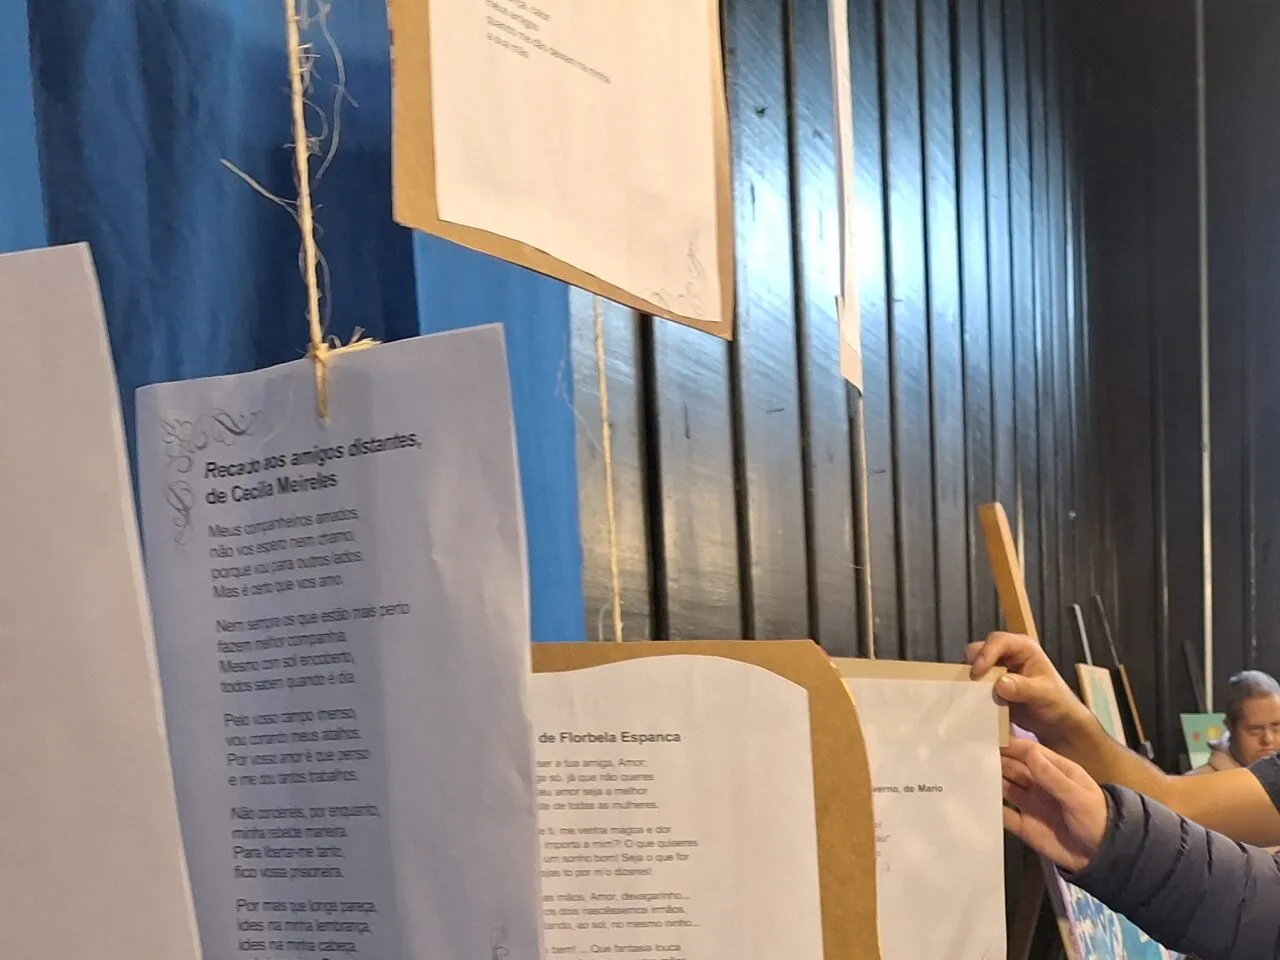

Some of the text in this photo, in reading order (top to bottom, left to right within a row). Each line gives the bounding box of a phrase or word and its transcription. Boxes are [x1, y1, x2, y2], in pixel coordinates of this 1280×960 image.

[291, 446, 344, 466] amigos
[206, 488, 227, 504] de
[539, 732, 681, 745] de Florbela Espanca
[904, 785, 915, 793] de
[624, 839, 633, 848] O
